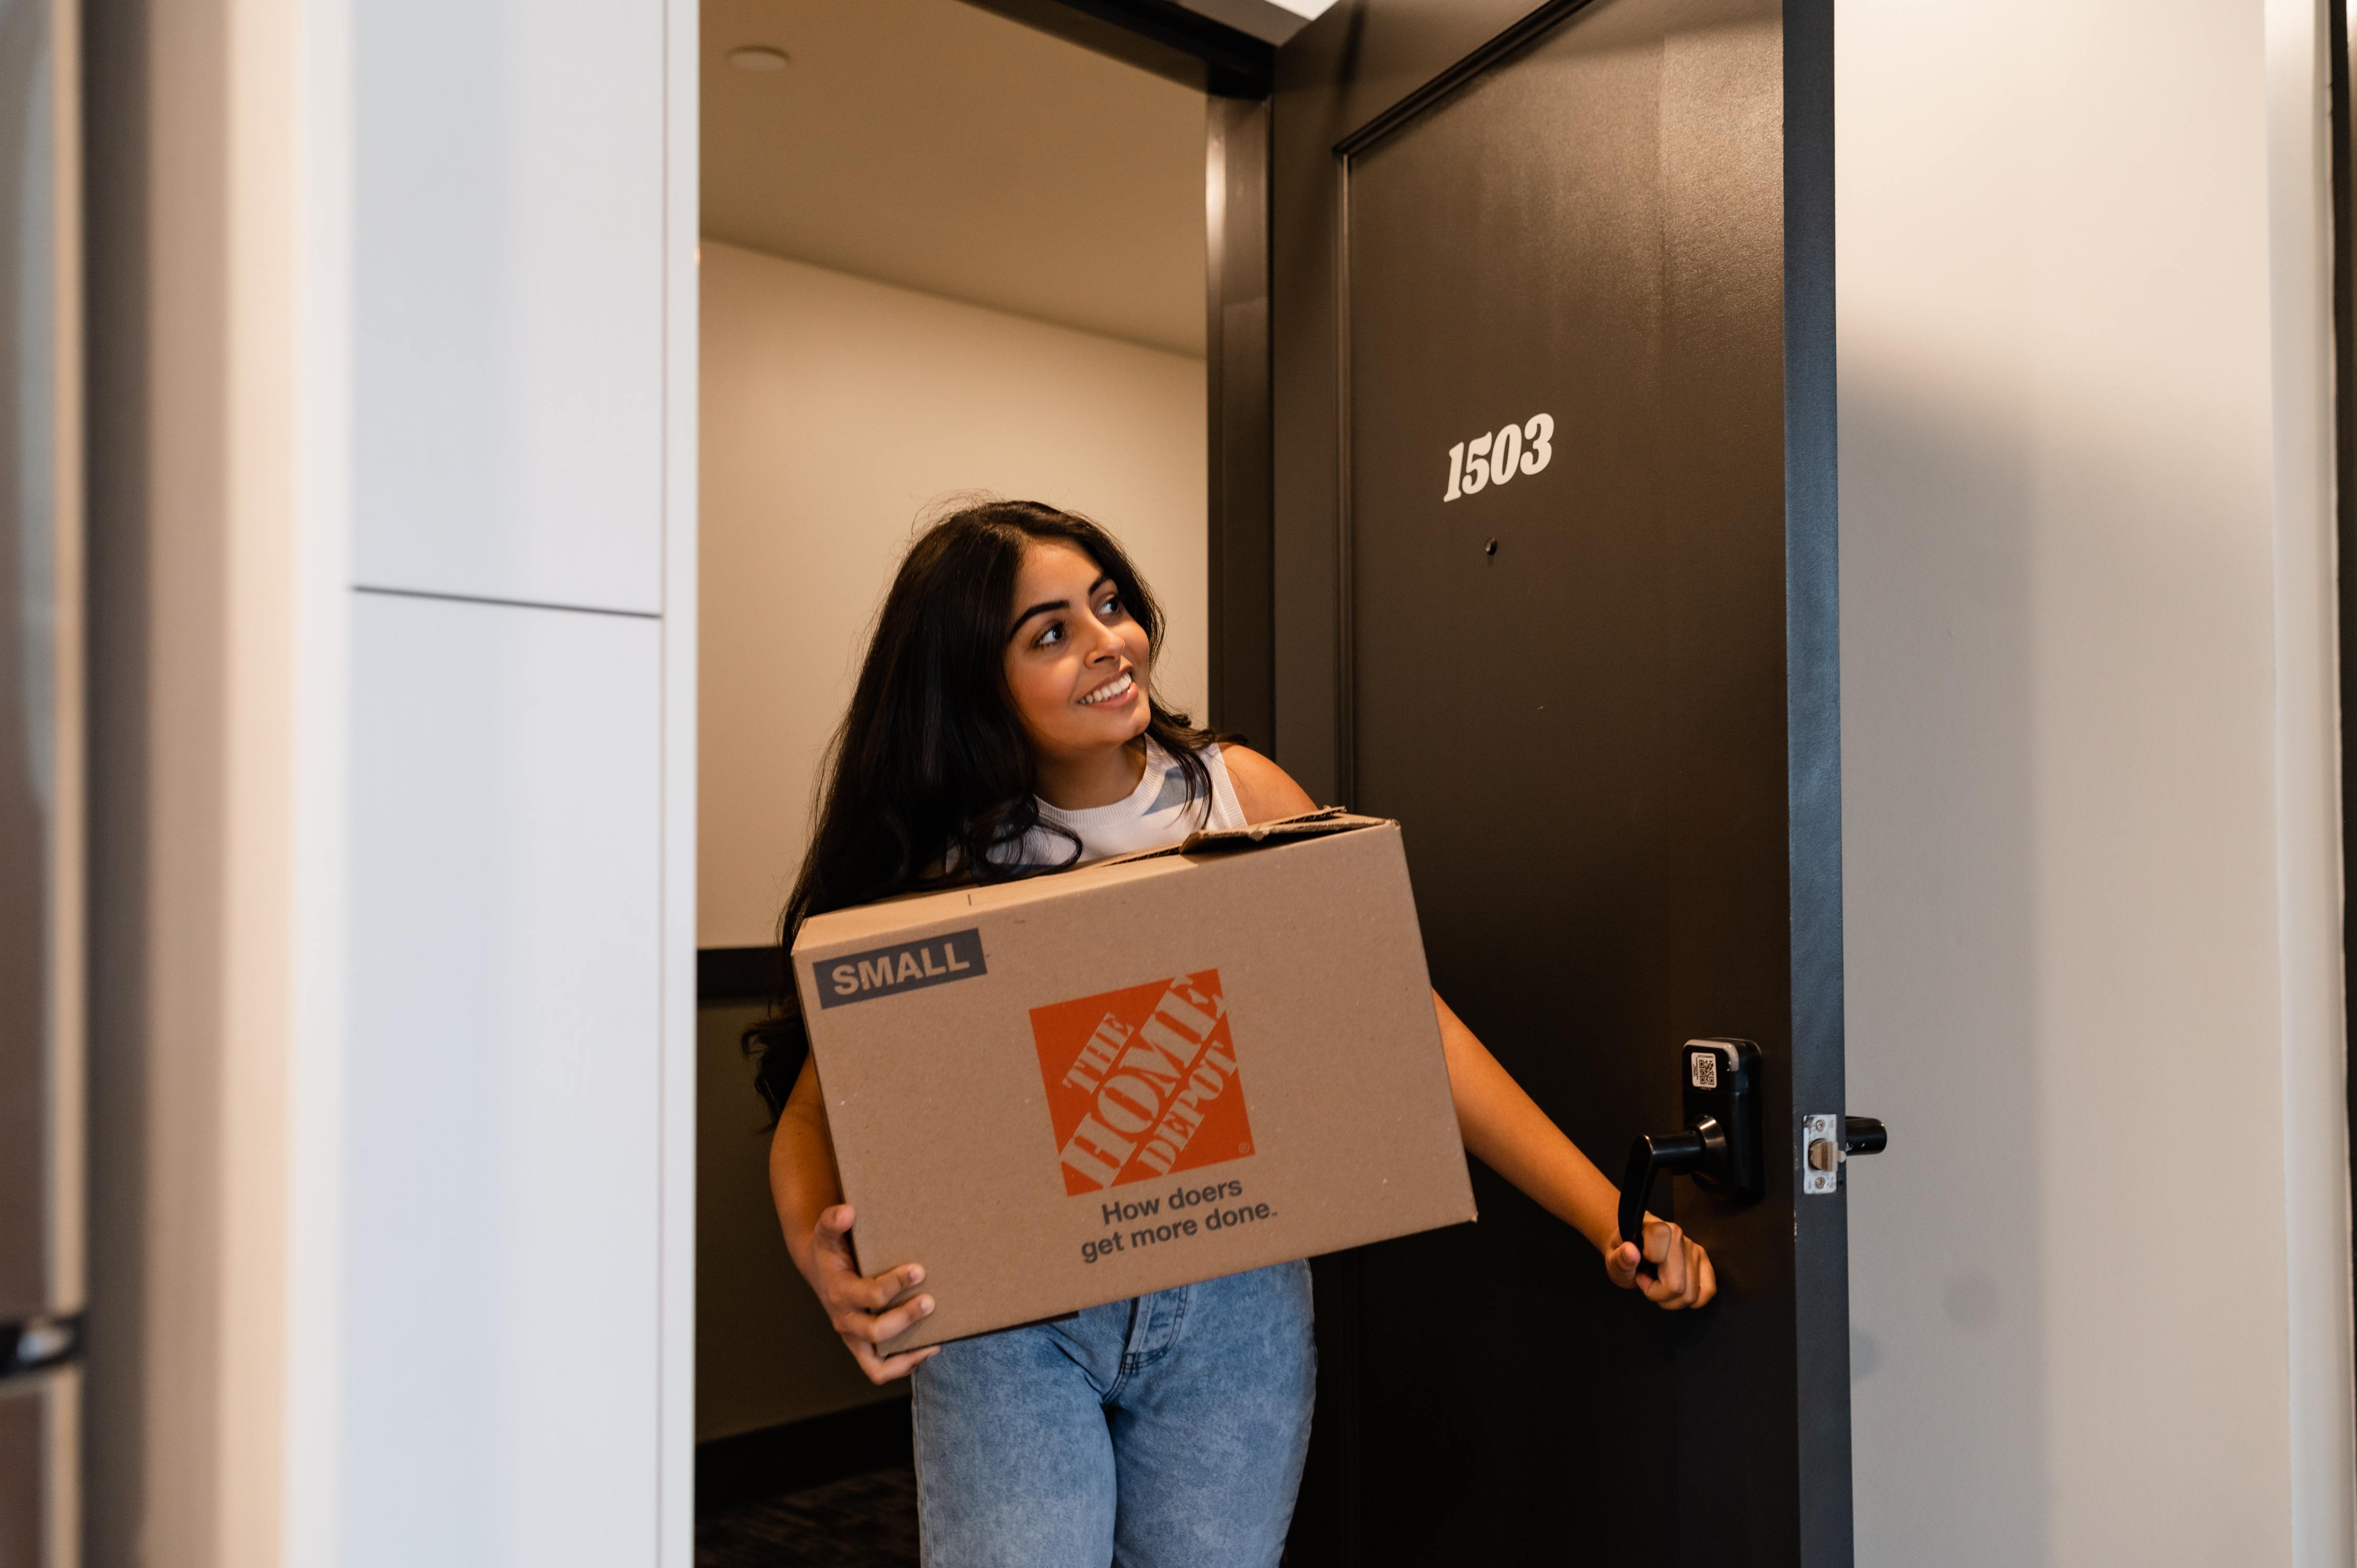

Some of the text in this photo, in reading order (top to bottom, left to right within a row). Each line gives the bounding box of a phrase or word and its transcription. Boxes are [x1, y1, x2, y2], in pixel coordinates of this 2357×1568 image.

[1444, 413, 1554, 502] 1503
[832, 943, 970, 995] SMALL
[1059, 974, 1226, 1188] HOME
[1061, 1011, 1135, 1095] THE
[1137, 1040, 1237, 1175] DEPOT
[1081, 1232, 1125, 1263] get
[1130, 1219, 1198, 1249] more
[1101, 1179, 1243, 1225] How doers
